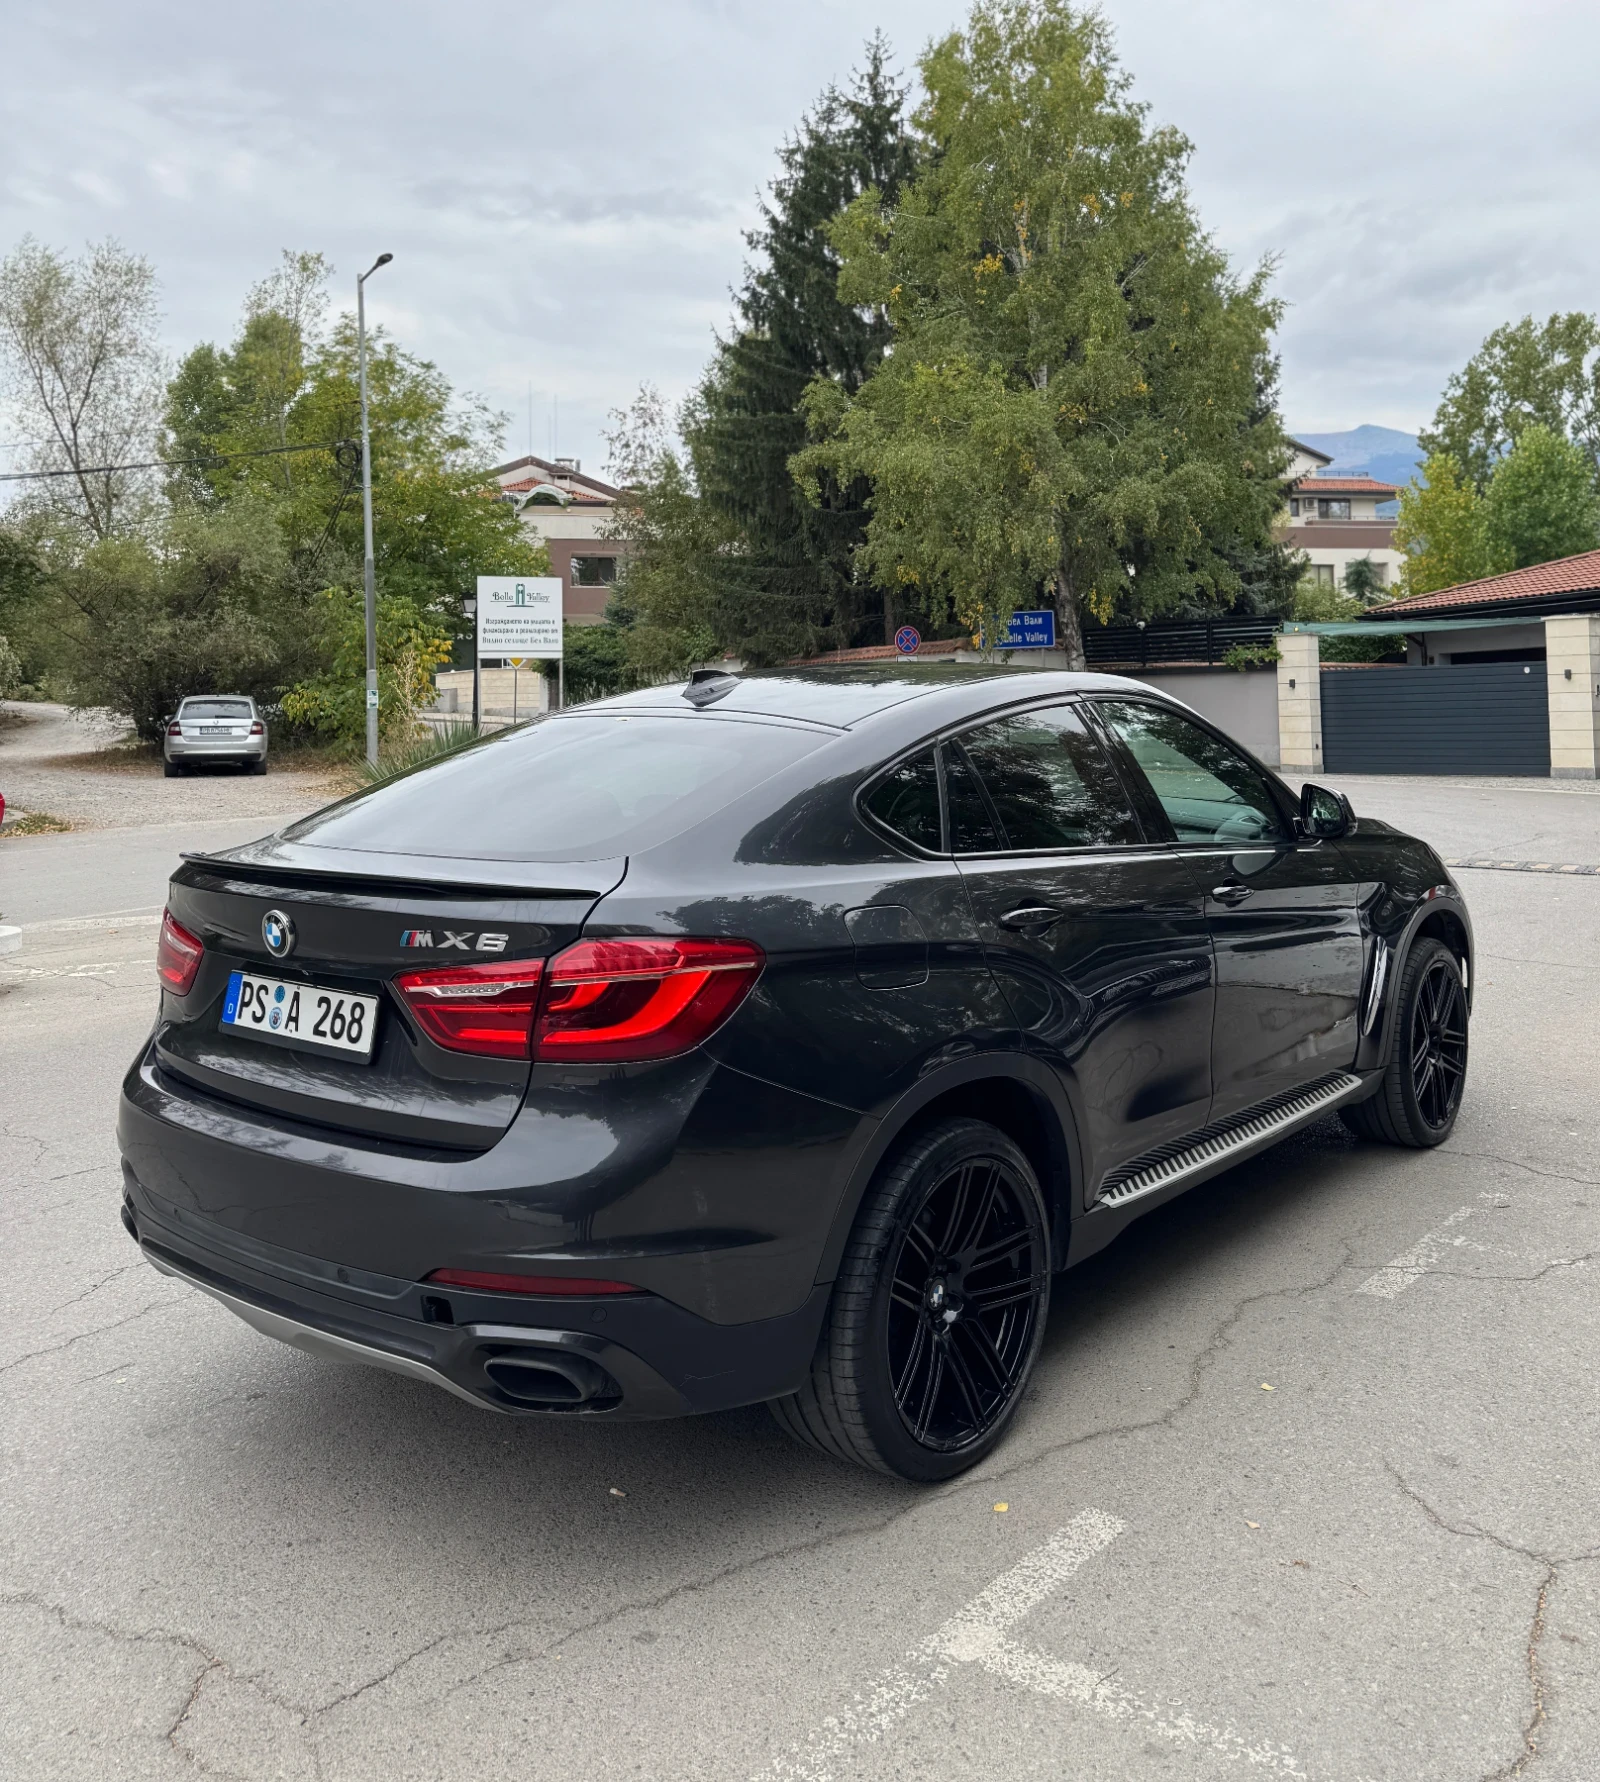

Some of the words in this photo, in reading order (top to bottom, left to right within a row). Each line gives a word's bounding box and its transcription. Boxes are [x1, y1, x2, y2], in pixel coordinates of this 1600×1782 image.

[492, 592, 514, 600] Belle
[1024, 615, 1043, 625] Вали
[1025, 632, 1048, 644] Valley
[228, 1003, 233, 1014] D
[237, 981, 270, 1023] PS
[284, 991, 300, 1032] A
[312, 996, 365, 1044] 268
